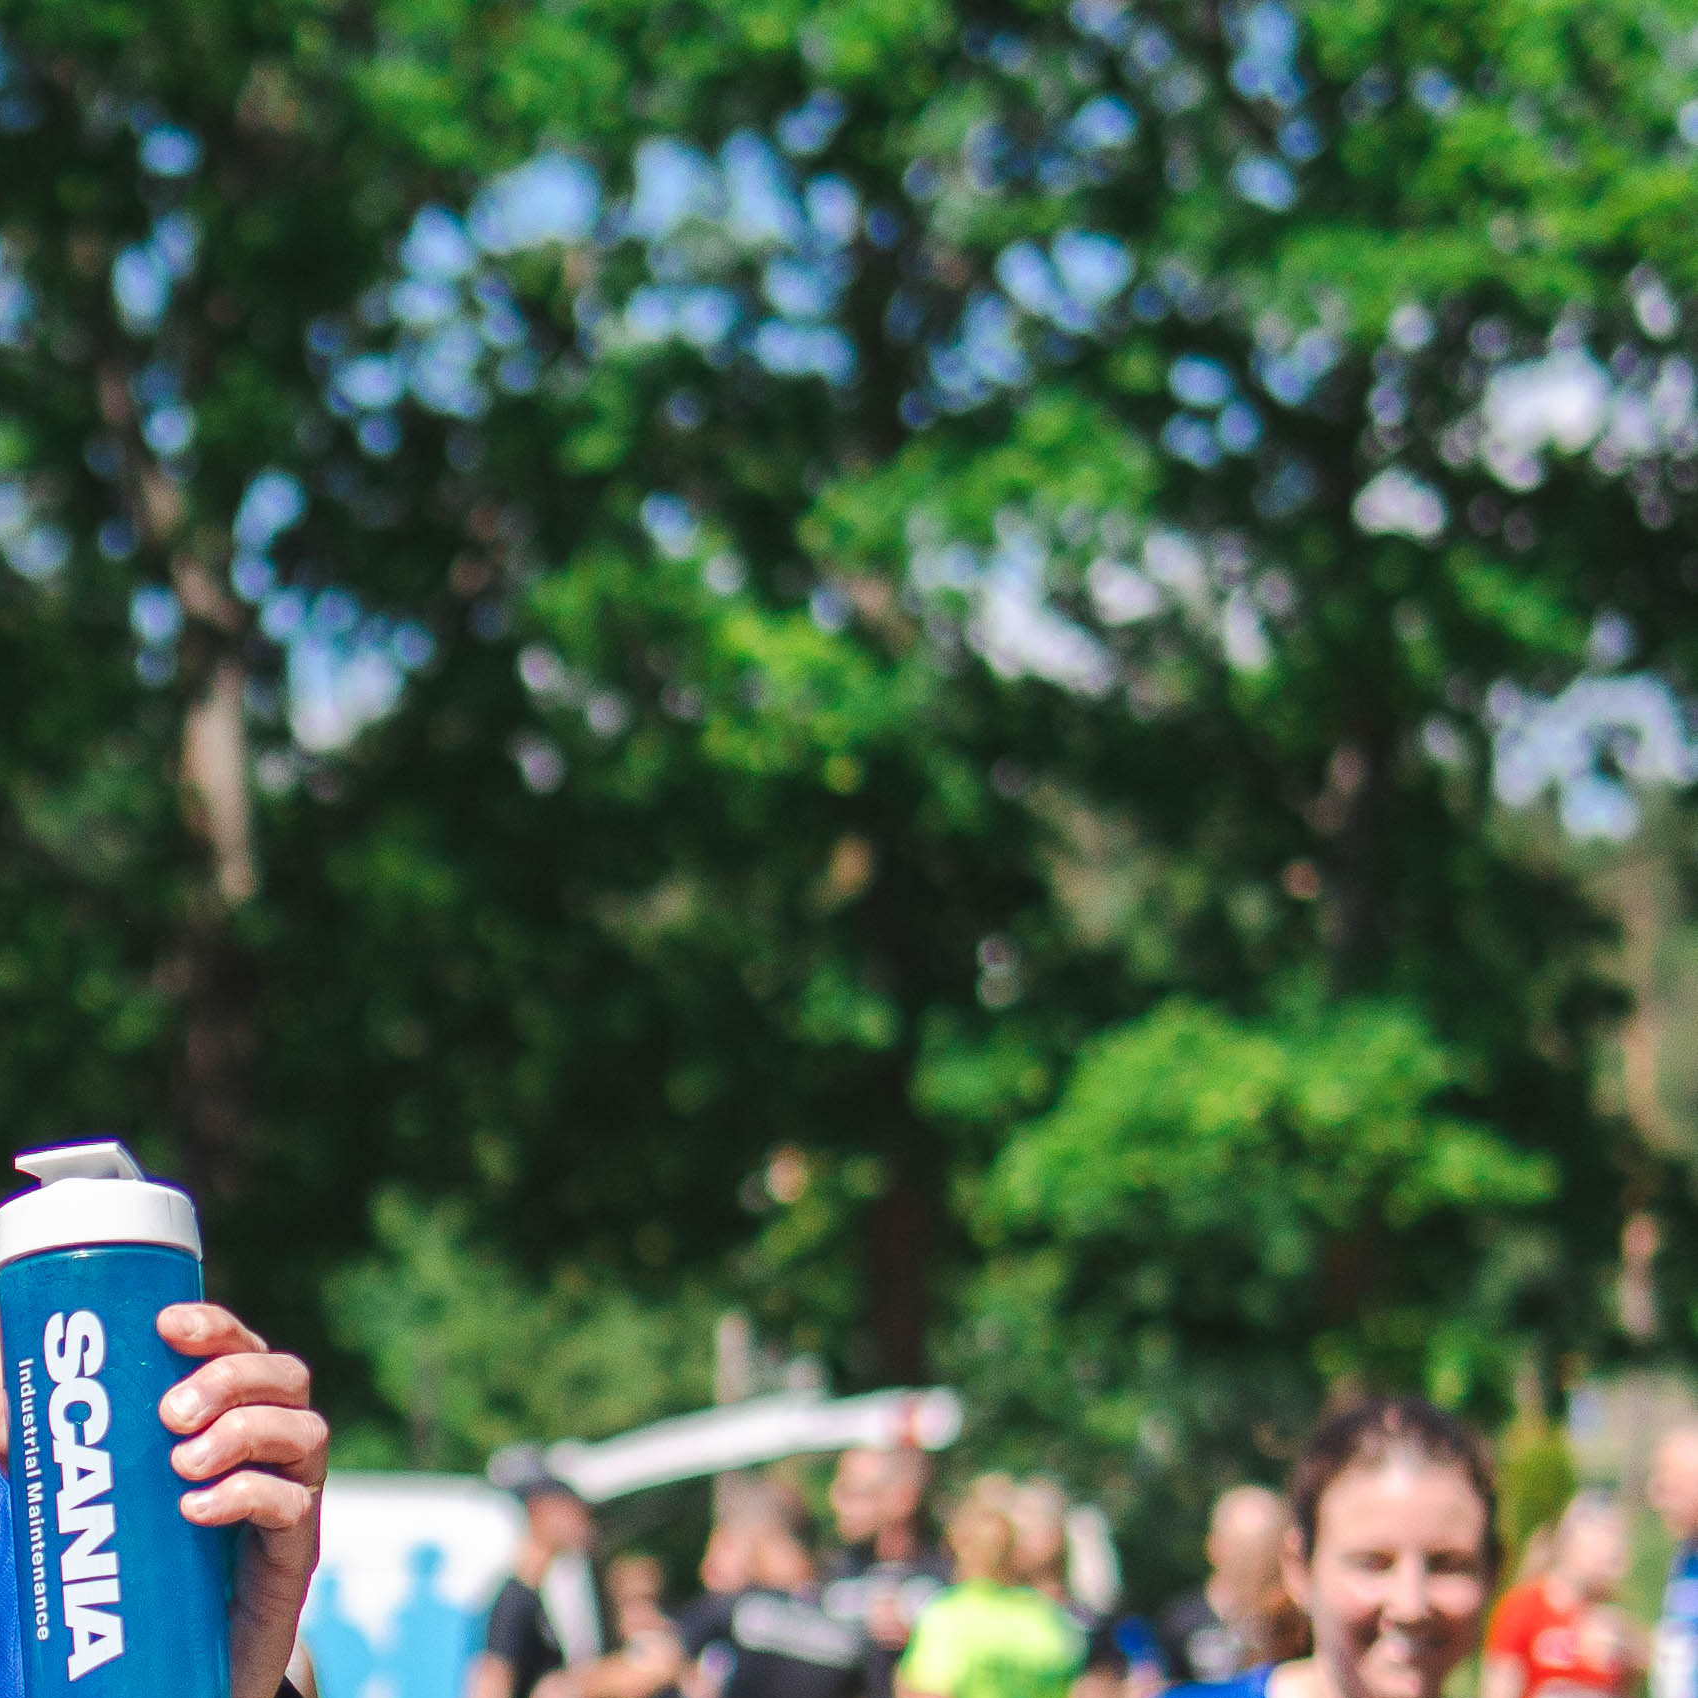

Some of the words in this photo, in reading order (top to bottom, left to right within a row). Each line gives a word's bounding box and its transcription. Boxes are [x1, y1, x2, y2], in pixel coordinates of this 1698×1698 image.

[18, 1357, 43, 1479] Industrial
[42, 1308, 126, 1683] SCANIA
[26, 1480, 50, 1642] Maintenance
